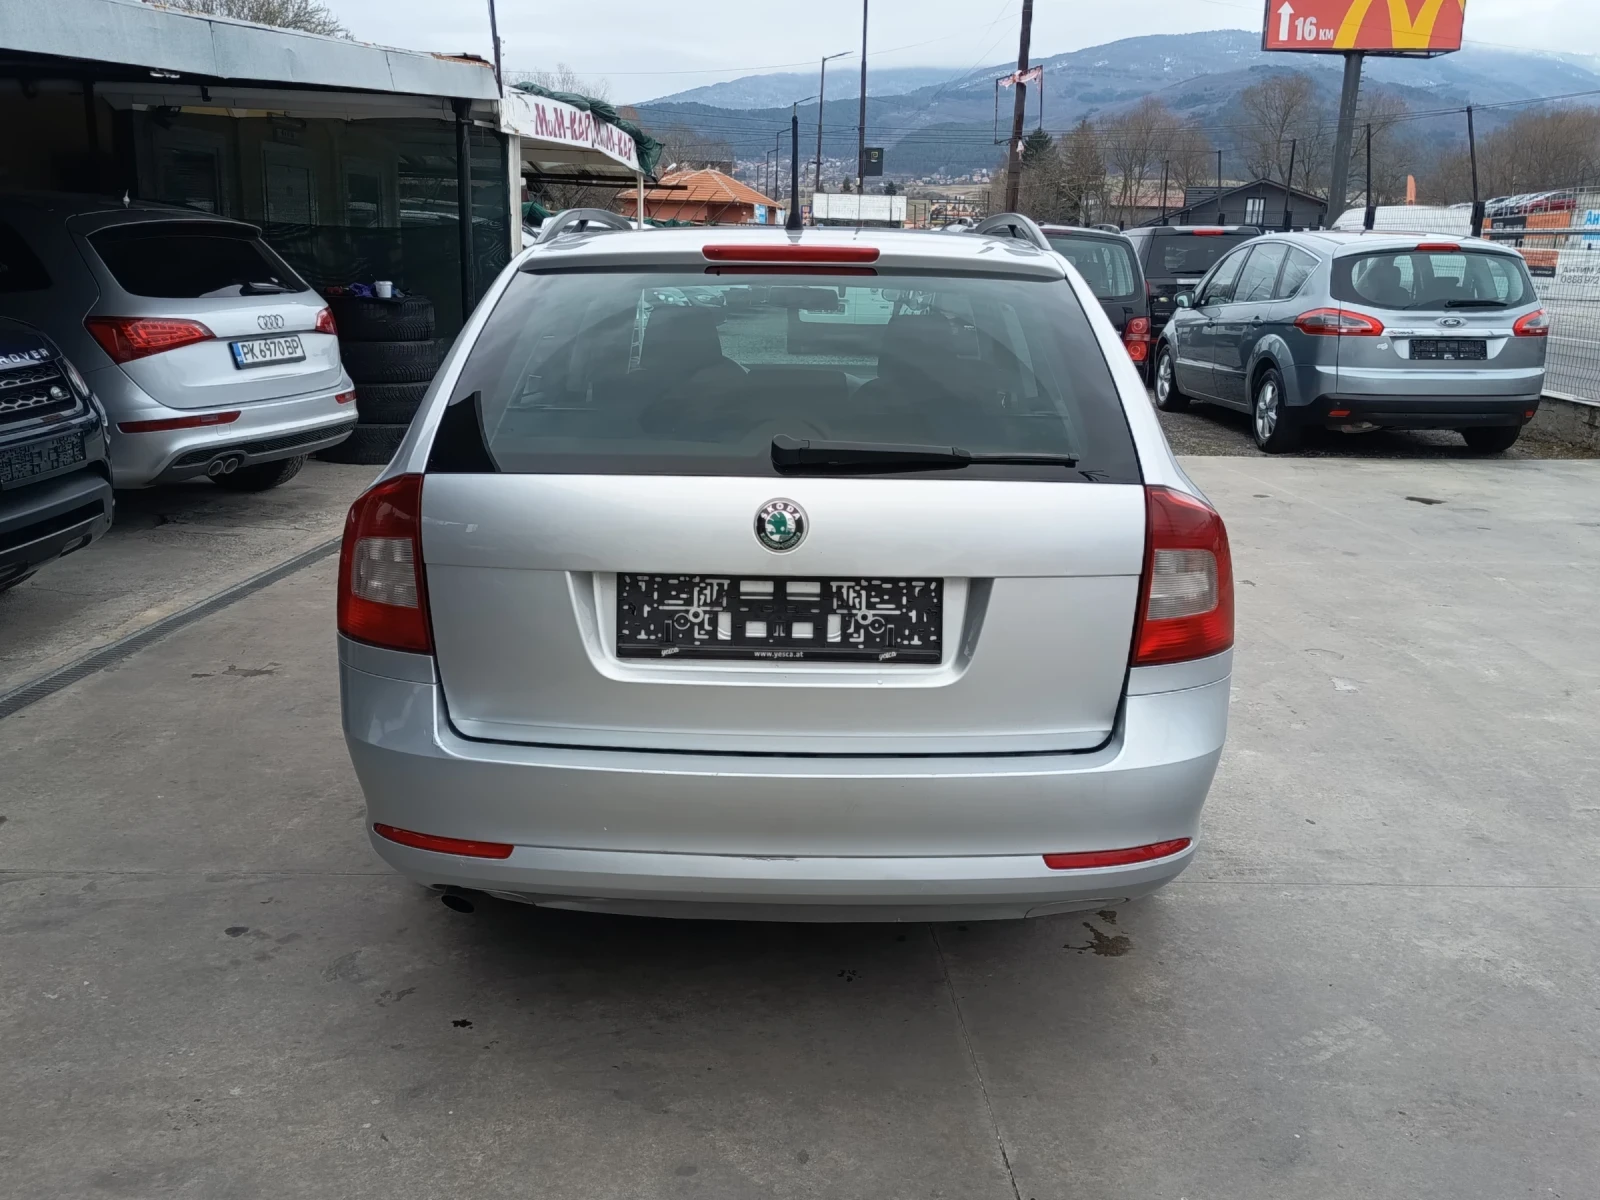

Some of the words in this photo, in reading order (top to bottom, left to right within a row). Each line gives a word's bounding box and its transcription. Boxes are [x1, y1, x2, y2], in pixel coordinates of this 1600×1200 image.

[1295, 16, 1317, 41] 16
[258, 339, 285, 358] 6970
[753, 650, 804, 658] www.yesca.at
